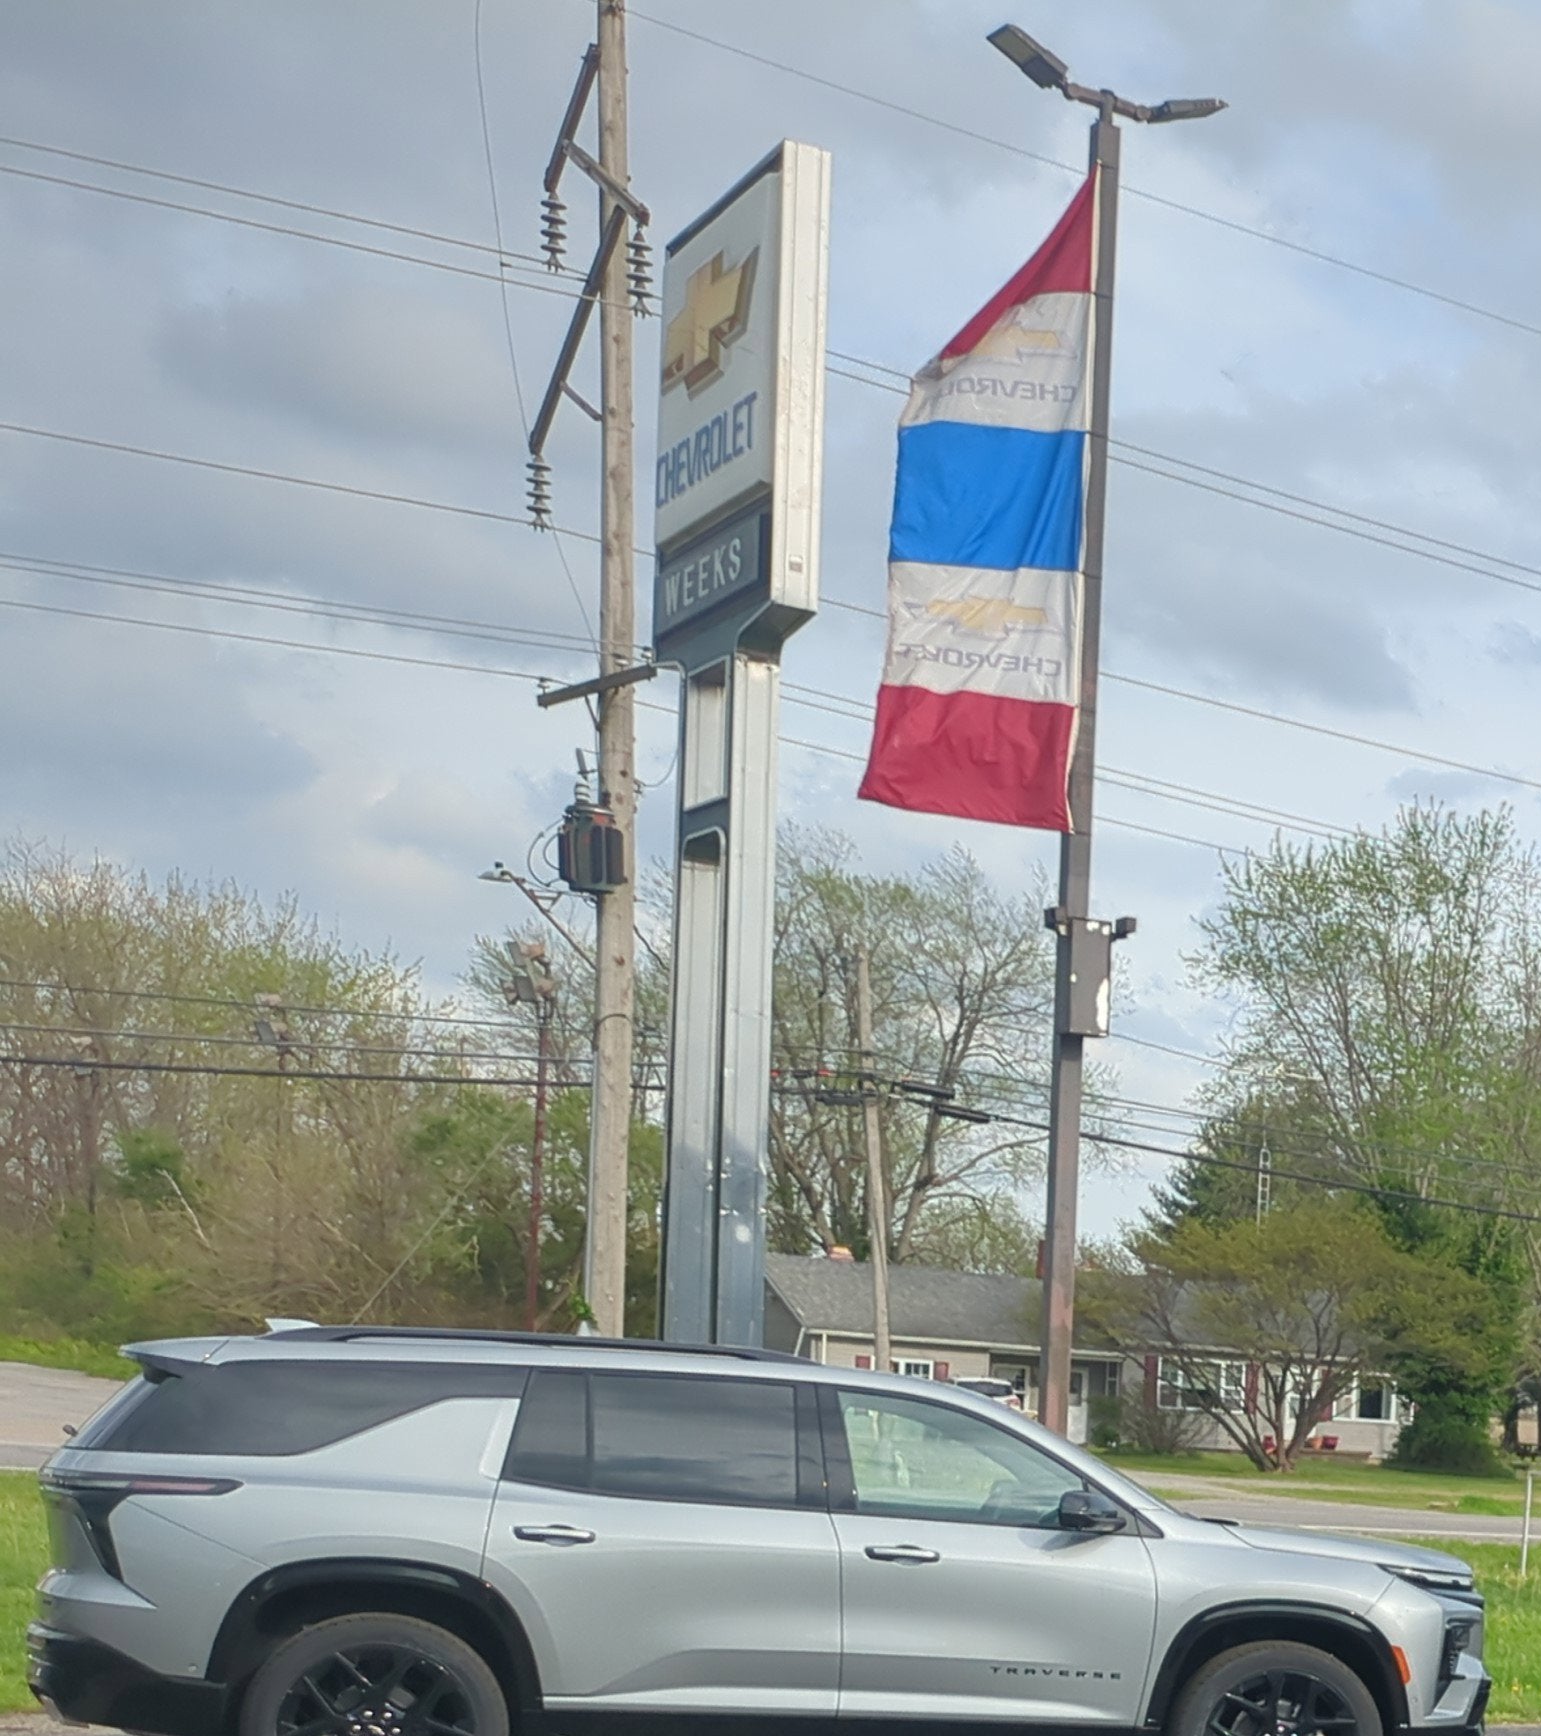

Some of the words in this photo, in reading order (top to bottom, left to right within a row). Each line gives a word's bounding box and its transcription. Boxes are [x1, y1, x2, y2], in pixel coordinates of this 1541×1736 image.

[656, 391, 758, 509] CHEVROLET
[664, 537, 741, 616] WEEKS
[990, 1666, 1121, 1680] TRAVERSE
